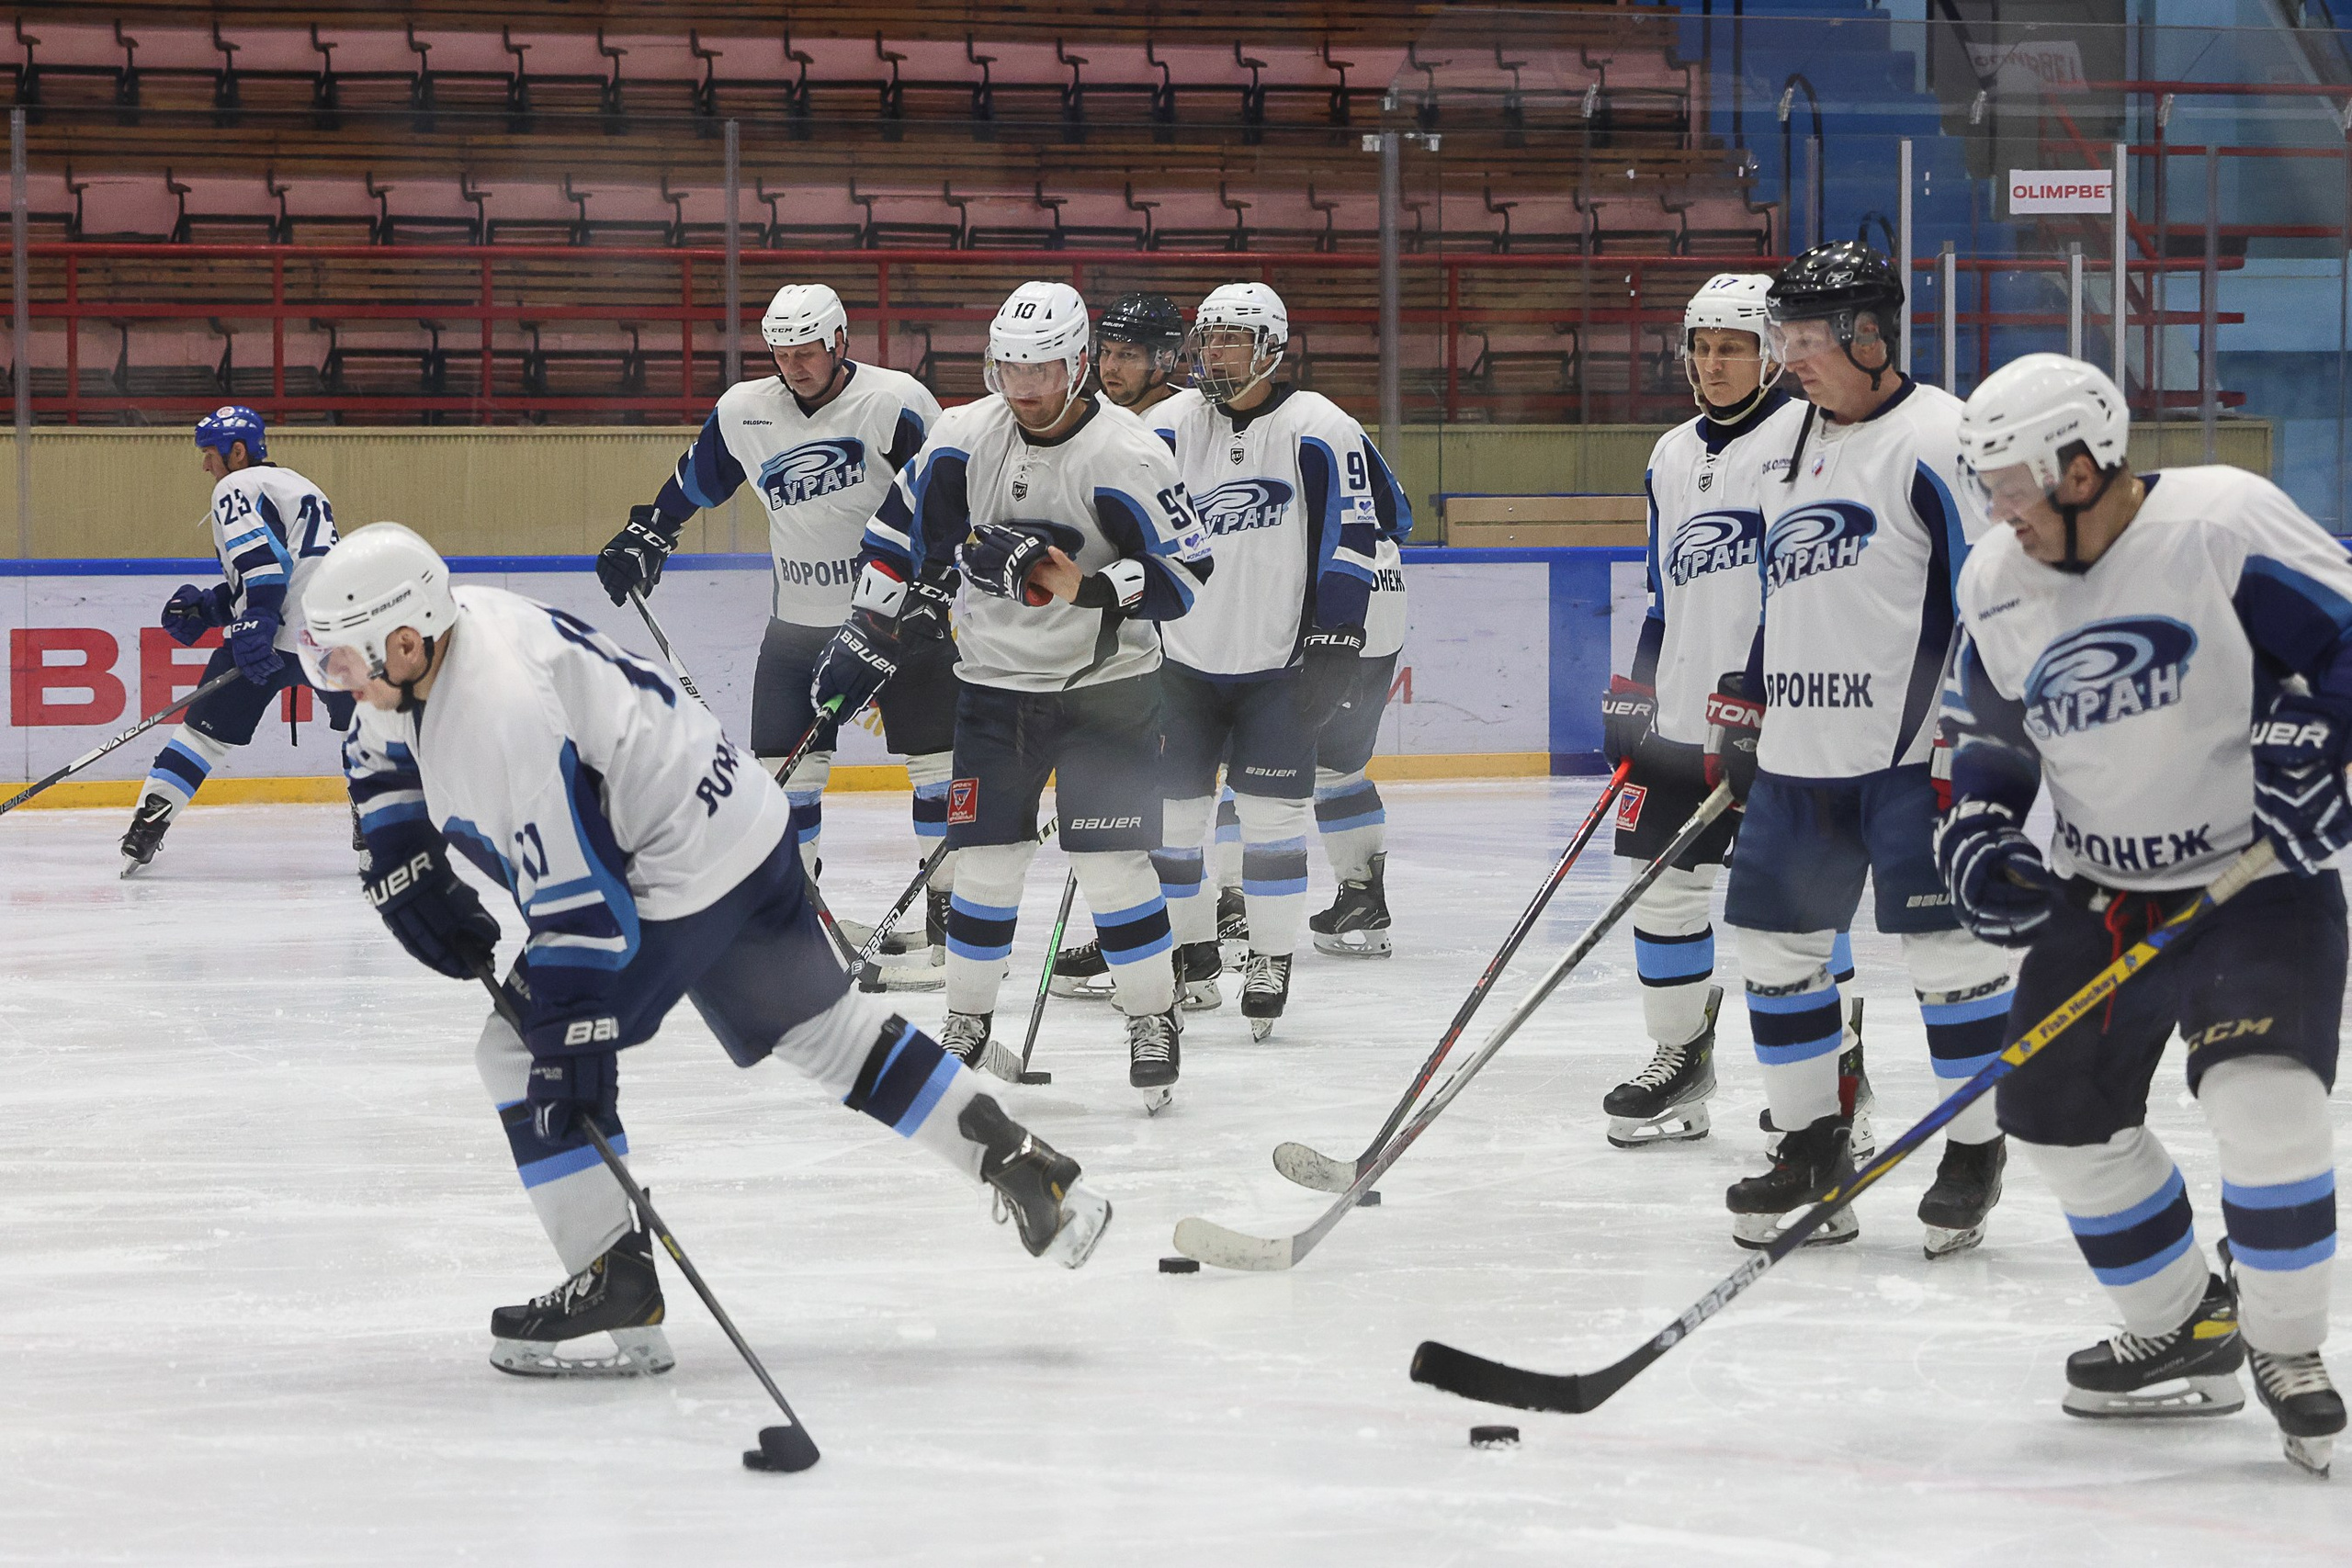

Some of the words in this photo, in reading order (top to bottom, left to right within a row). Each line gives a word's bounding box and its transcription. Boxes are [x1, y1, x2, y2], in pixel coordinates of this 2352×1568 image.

[1012, 302, 1037, 319] 10
[769, 462, 865, 512] БУРАН
[220, 489, 252, 525] 23
[1204, 502, 1283, 540] УРАН
[627, 521, 673, 558] CCM
[779, 556, 859, 587] ВОРОНЕ
[371, 589, 413, 616] BAUER
[232, 620, 259, 634] CM
[839, 629, 898, 678] BAUER
[10, 626, 313, 727] BE
[1766, 671, 1873, 708] РОНЕЖ
[1602, 700, 1653, 716] UER
[1708, 698, 1763, 729] TON
[2023, 662, 2180, 740] БУРАН
[2250, 721, 2331, 750] UER
[1245, 766, 1297, 778] BAUER
[1070, 815, 1141, 830] BAUER
[364, 851, 434, 907] UER
[2039, 1013, 2069, 1039] Fish
[2068, 974, 2118, 1015] Hockey
